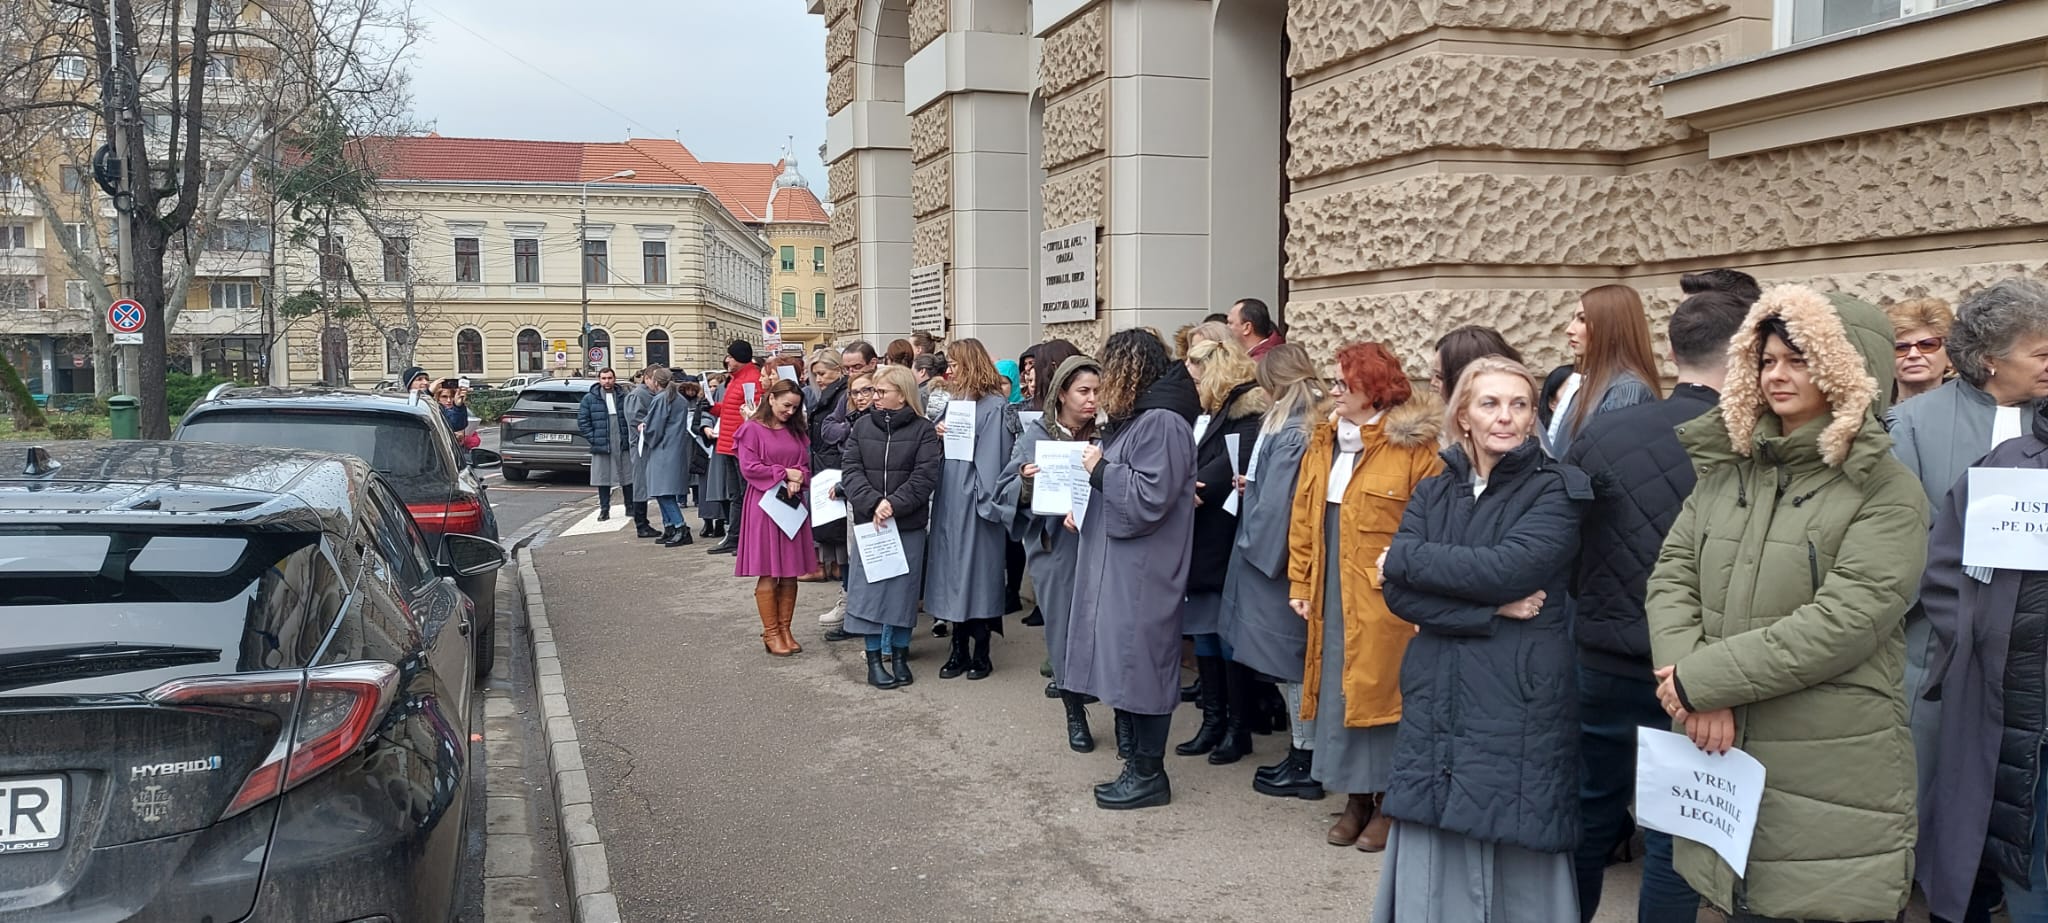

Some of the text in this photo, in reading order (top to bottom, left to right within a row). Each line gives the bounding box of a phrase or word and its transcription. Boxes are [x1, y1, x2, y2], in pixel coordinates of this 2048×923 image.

[132, 760, 207, 777] HYBRID
[1693, 770, 1737, 796] VREM
[1671, 785, 1742, 823] SALARIILE
[1679, 805, 1735, 838] LEGALE!
[6, 841, 49, 850] LEXUS
